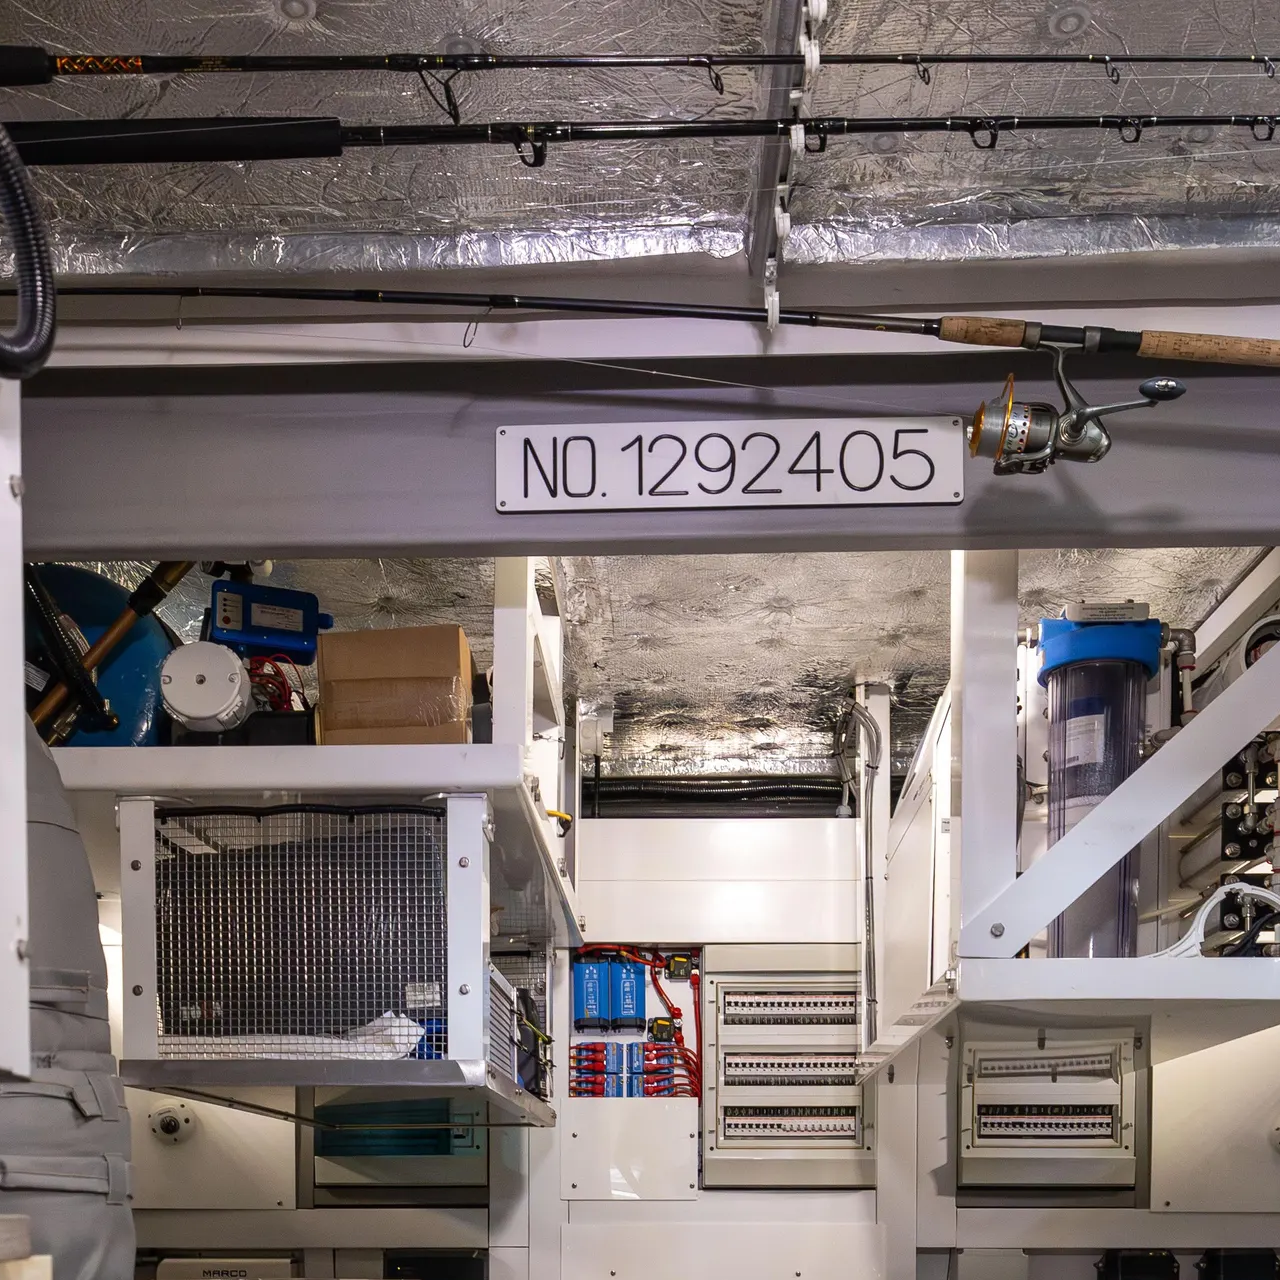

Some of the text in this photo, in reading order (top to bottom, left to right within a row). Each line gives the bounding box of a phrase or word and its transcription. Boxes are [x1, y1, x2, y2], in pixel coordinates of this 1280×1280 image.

[522, 436, 608, 499] NO.
[620, 428, 936, 497] 1292405
[202, 1270, 247, 1278] MARCO
